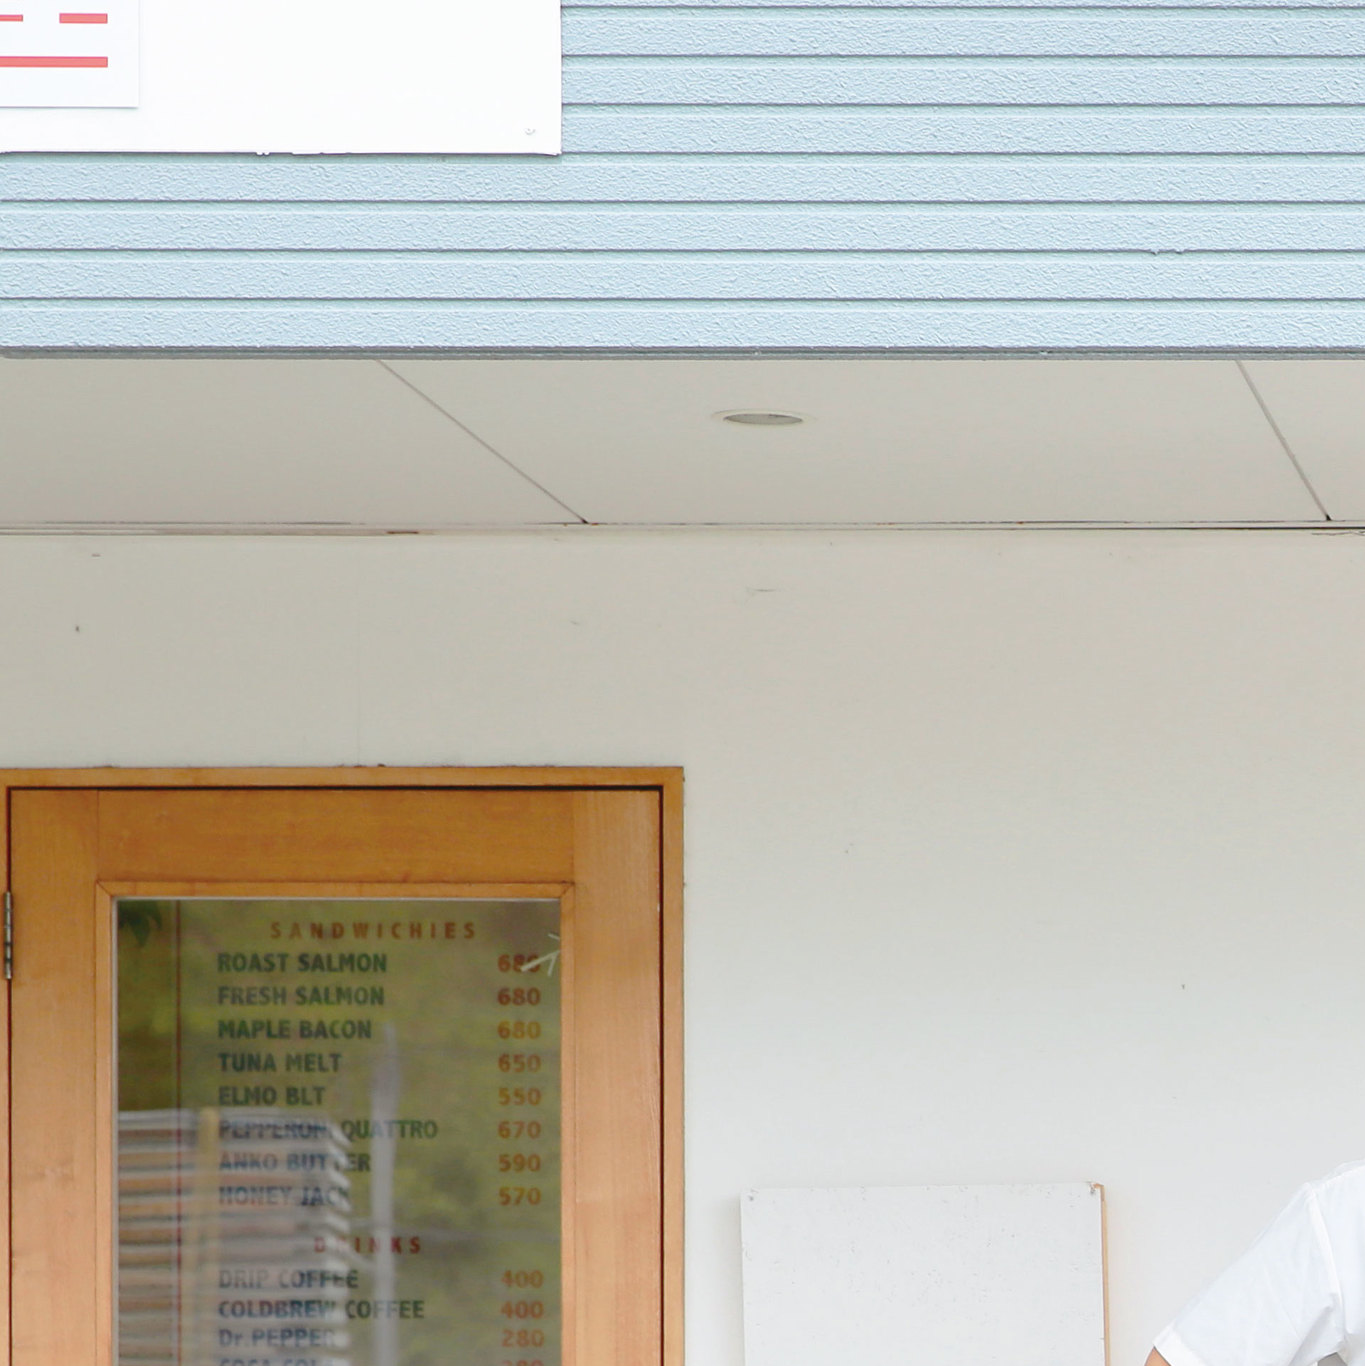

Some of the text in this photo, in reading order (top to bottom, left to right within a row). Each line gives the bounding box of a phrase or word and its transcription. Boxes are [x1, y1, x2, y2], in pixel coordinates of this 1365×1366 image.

[270, 922, 477, 940] SANDWICHIES
[217, 953, 289, 973] ROAST
[297, 953, 388, 973] SALMON
[217, 986, 542, 1006] FRESH SALMON 680
[217, 1020, 542, 1040] MAPLE BACON 680
[218, 1053, 542, 1073] TUNA MELT 650
[218, 1086, 542, 1106] ELMO BLT 550
[341, 1119, 439, 1140] QUATTRO
[497, 1120, 542, 1139] 670
[498, 1153, 542, 1172] 590
[498, 1186, 542, 1206] 570
[218, 1269, 545, 1289] DRIP COFFEE 400
[344, 1300, 425, 1320] COFFEE
[499, 1301, 545, 1319] 400
[501, 1329, 545, 1348] 280
